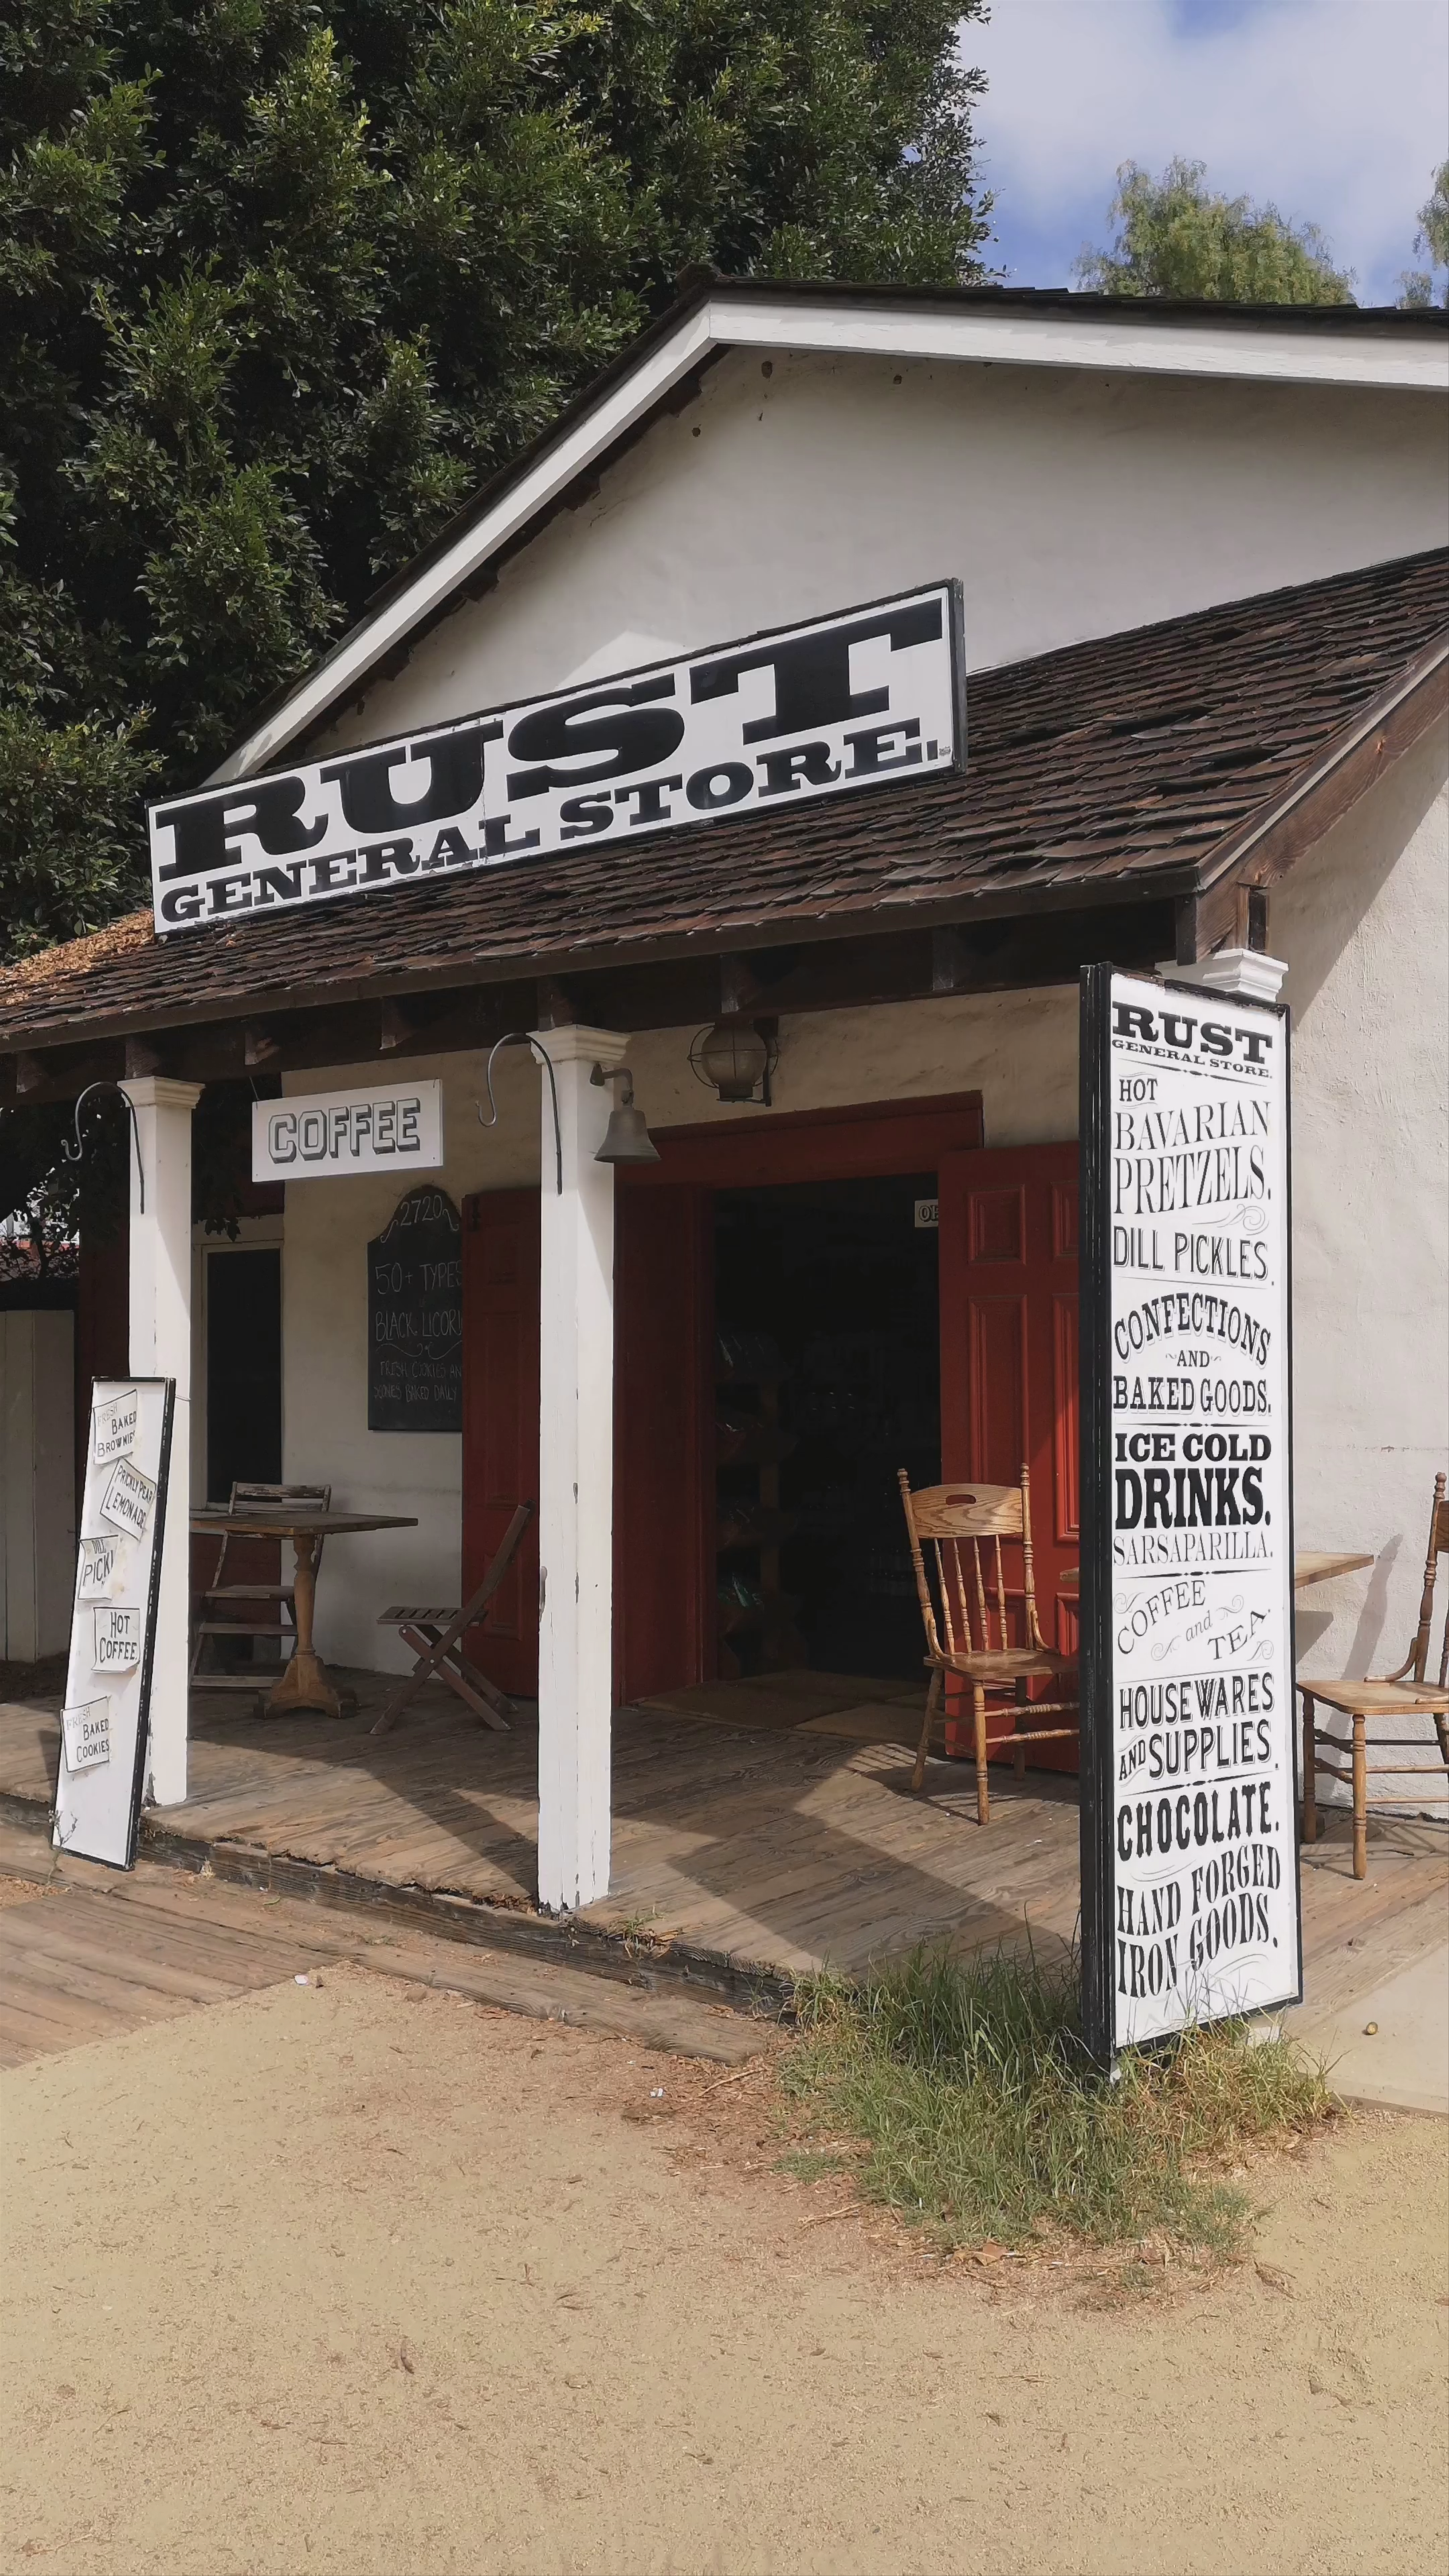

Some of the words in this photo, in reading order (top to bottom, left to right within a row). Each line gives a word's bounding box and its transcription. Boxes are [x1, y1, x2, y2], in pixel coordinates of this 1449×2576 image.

[157, 597, 943, 883] RUST
[160, 814, 541, 923] GENERAL
[560, 718, 938, 842] STORE.
[1112, 1001, 1273, 1065] RUST
[1111, 1039, 1206, 1066] GENERAL
[1209, 1058, 1273, 1079] STORE.
[1119, 1078, 1158, 1102] HOT
[268, 1097, 421, 1164] COFFEE
[1114, 1100, 1271, 1151] BAVARIAN
[1113, 1144, 1271, 1215] PRETZELS.
[400, 1195, 443, 1227] 2720
[1113, 1225, 1165, 1272] DILL
[375, 1261, 414, 1295] 50+
[375, 1311, 418, 1342] BLACK
[422, 1309, 462, 1337] LICORI
[1114, 1292, 1271, 1369] CONFECTIONS
[380, 1360, 408, 1378] FRESH
[411, 1361, 446, 1378] COOKIES
[449, 1363, 462, 1378] AN
[1177, 1350, 1211, 1368] AND
[405, 1384, 430, 1403] BAKED
[434, 1384, 457, 1403] DAILY
[1113, 1375, 1195, 1414] BAKED
[1200, 1378, 1272, 1416] GOODS.
[111, 1410, 137, 1435] BAKED
[1115, 1433, 1176, 1463] ICE
[1182, 1433, 1272, 1462] COLD
[114, 1464, 139, 1493] PRICKLY
[1115, 1466, 1271, 1530] DRINKS.
[1113, 1530, 1273, 1566] SARSAPARILLA.
[110, 1612, 131, 1638] HOT
[1117, 1579, 1206, 1655] COFFEE
[1186, 1610, 1213, 1642] and
[1119, 1672, 1275, 1731] HOUSEWARES
[83, 1718, 109, 1741] BAKED
[1118, 1739, 1146, 1781] AND
[1117, 1781, 1279, 1862] CHOCOLATE.
[1116, 1881, 1181, 1936] HAND
[1191, 1843, 1281, 1916] FORGED
[1117, 1933, 1178, 1998] IRON
[1189, 1892, 1278, 1972] GOODS.
